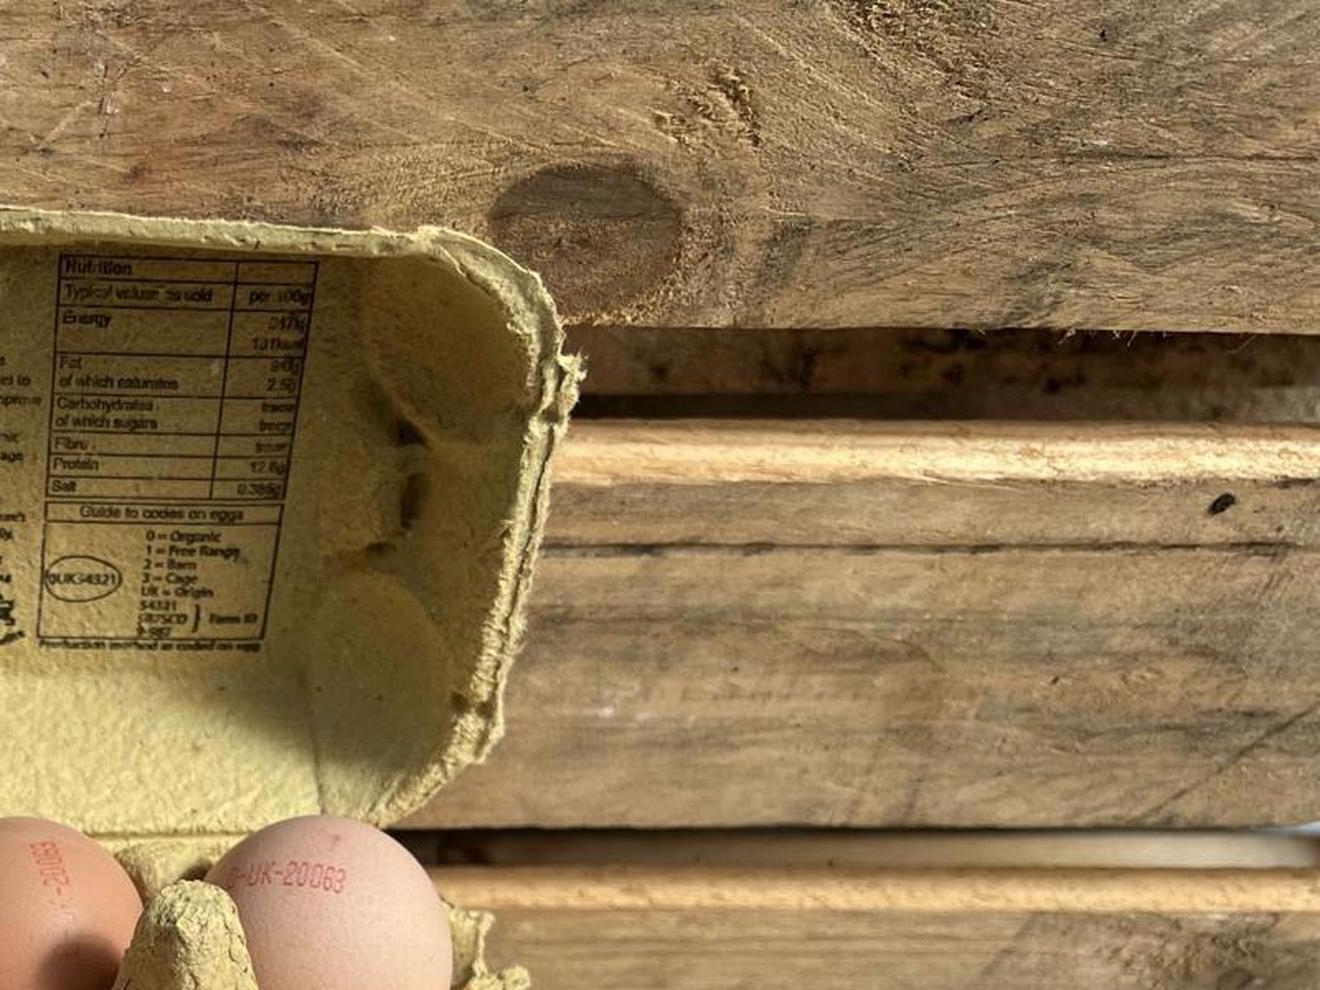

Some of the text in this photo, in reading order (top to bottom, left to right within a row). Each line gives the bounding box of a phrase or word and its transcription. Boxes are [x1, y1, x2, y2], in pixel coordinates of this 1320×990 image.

[64, 259, 133, 276] Nutrition
[17, 373, 30, 386] to
[80, 505, 122, 519] Guide
[125, 506, 139, 519] to
[188, 510, 207, 520] on
[169, 530, 222, 545] Organic
